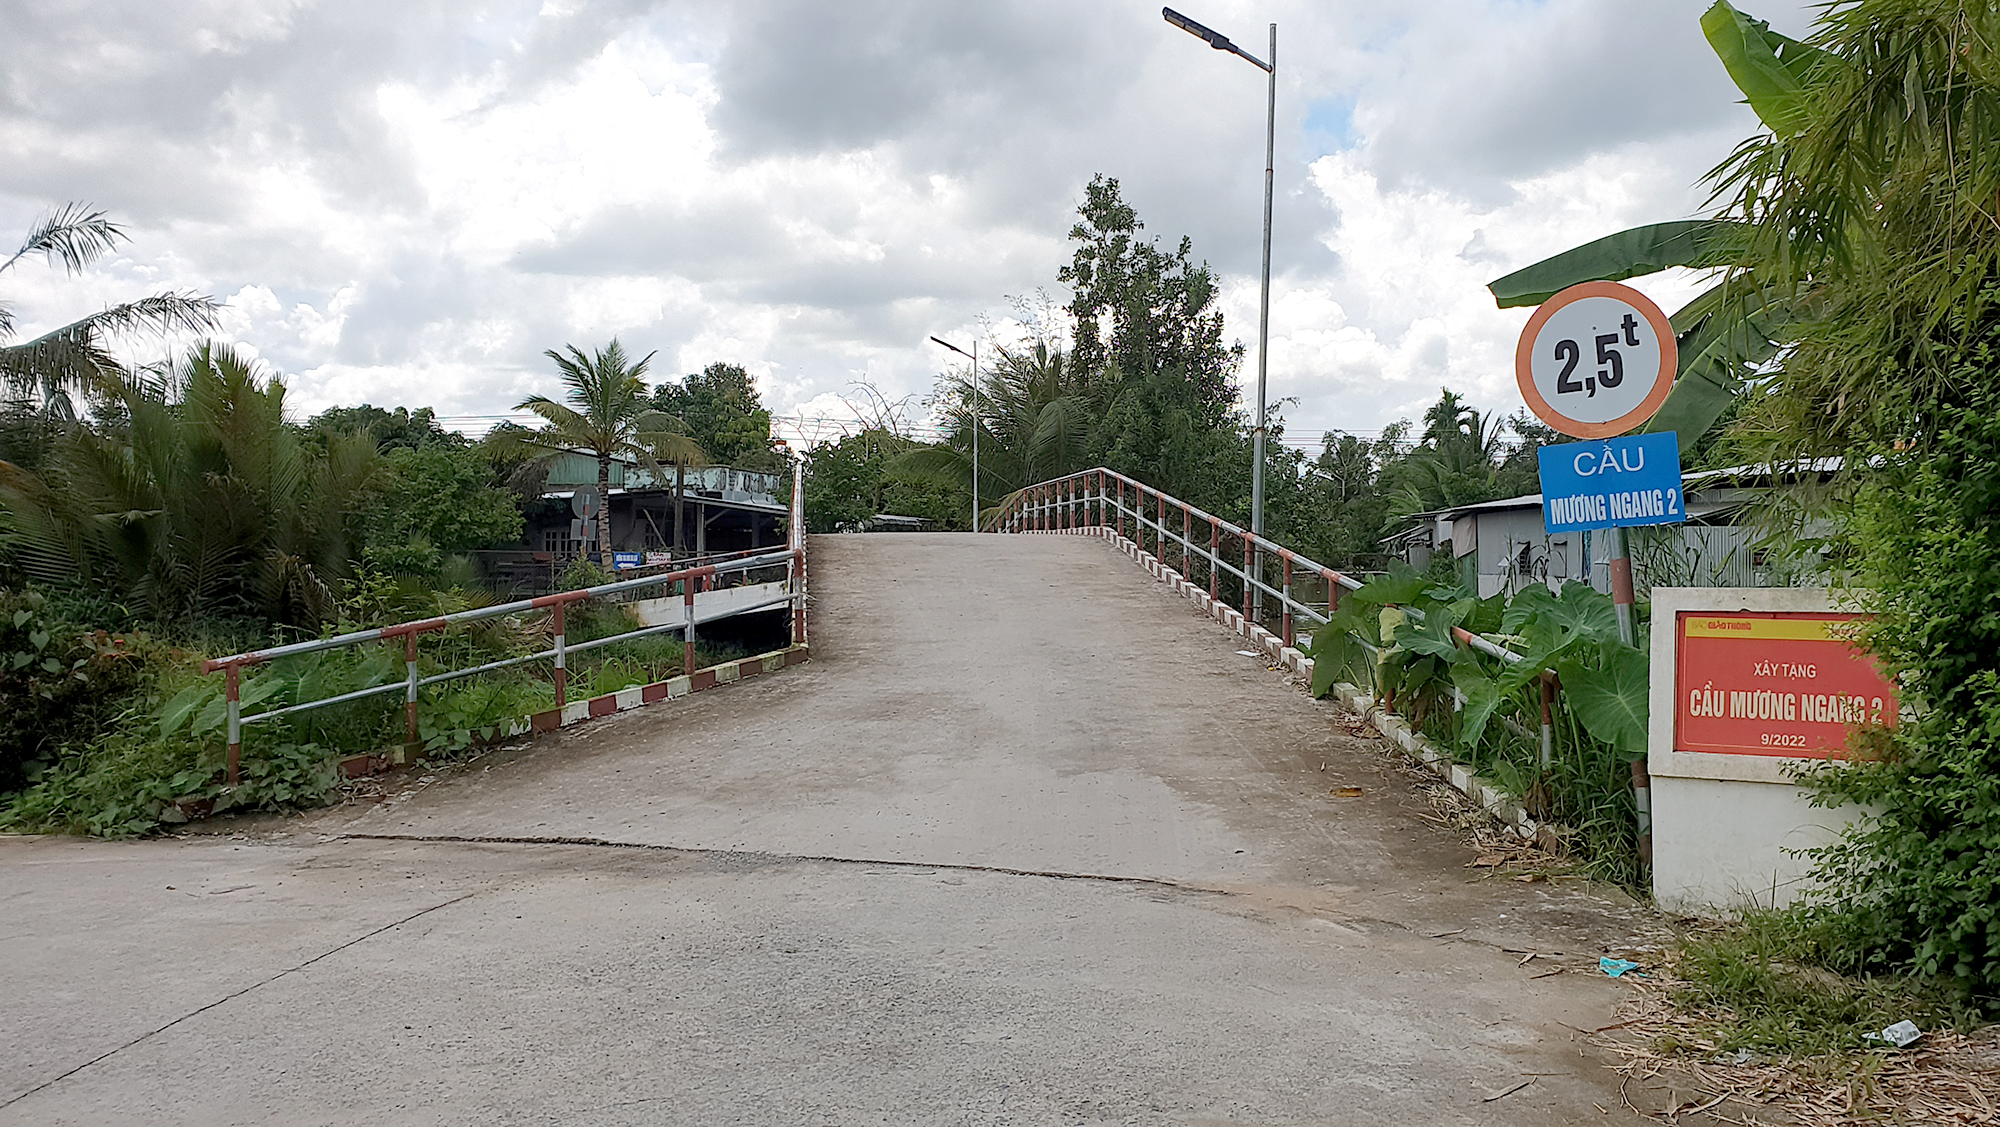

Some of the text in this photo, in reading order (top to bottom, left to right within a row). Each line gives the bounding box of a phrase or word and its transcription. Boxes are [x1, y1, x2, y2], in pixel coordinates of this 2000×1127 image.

[1573, 445, 1645, 477] CẦU
[1550, 487, 1679, 525] MƯƠNG NGANG 2
[1753, 659, 1779, 677] XÂY
[1689, 681, 1884, 725] CẦU MƯƠNG NGANG 2
[1760, 733, 1806, 748] 9/2022
